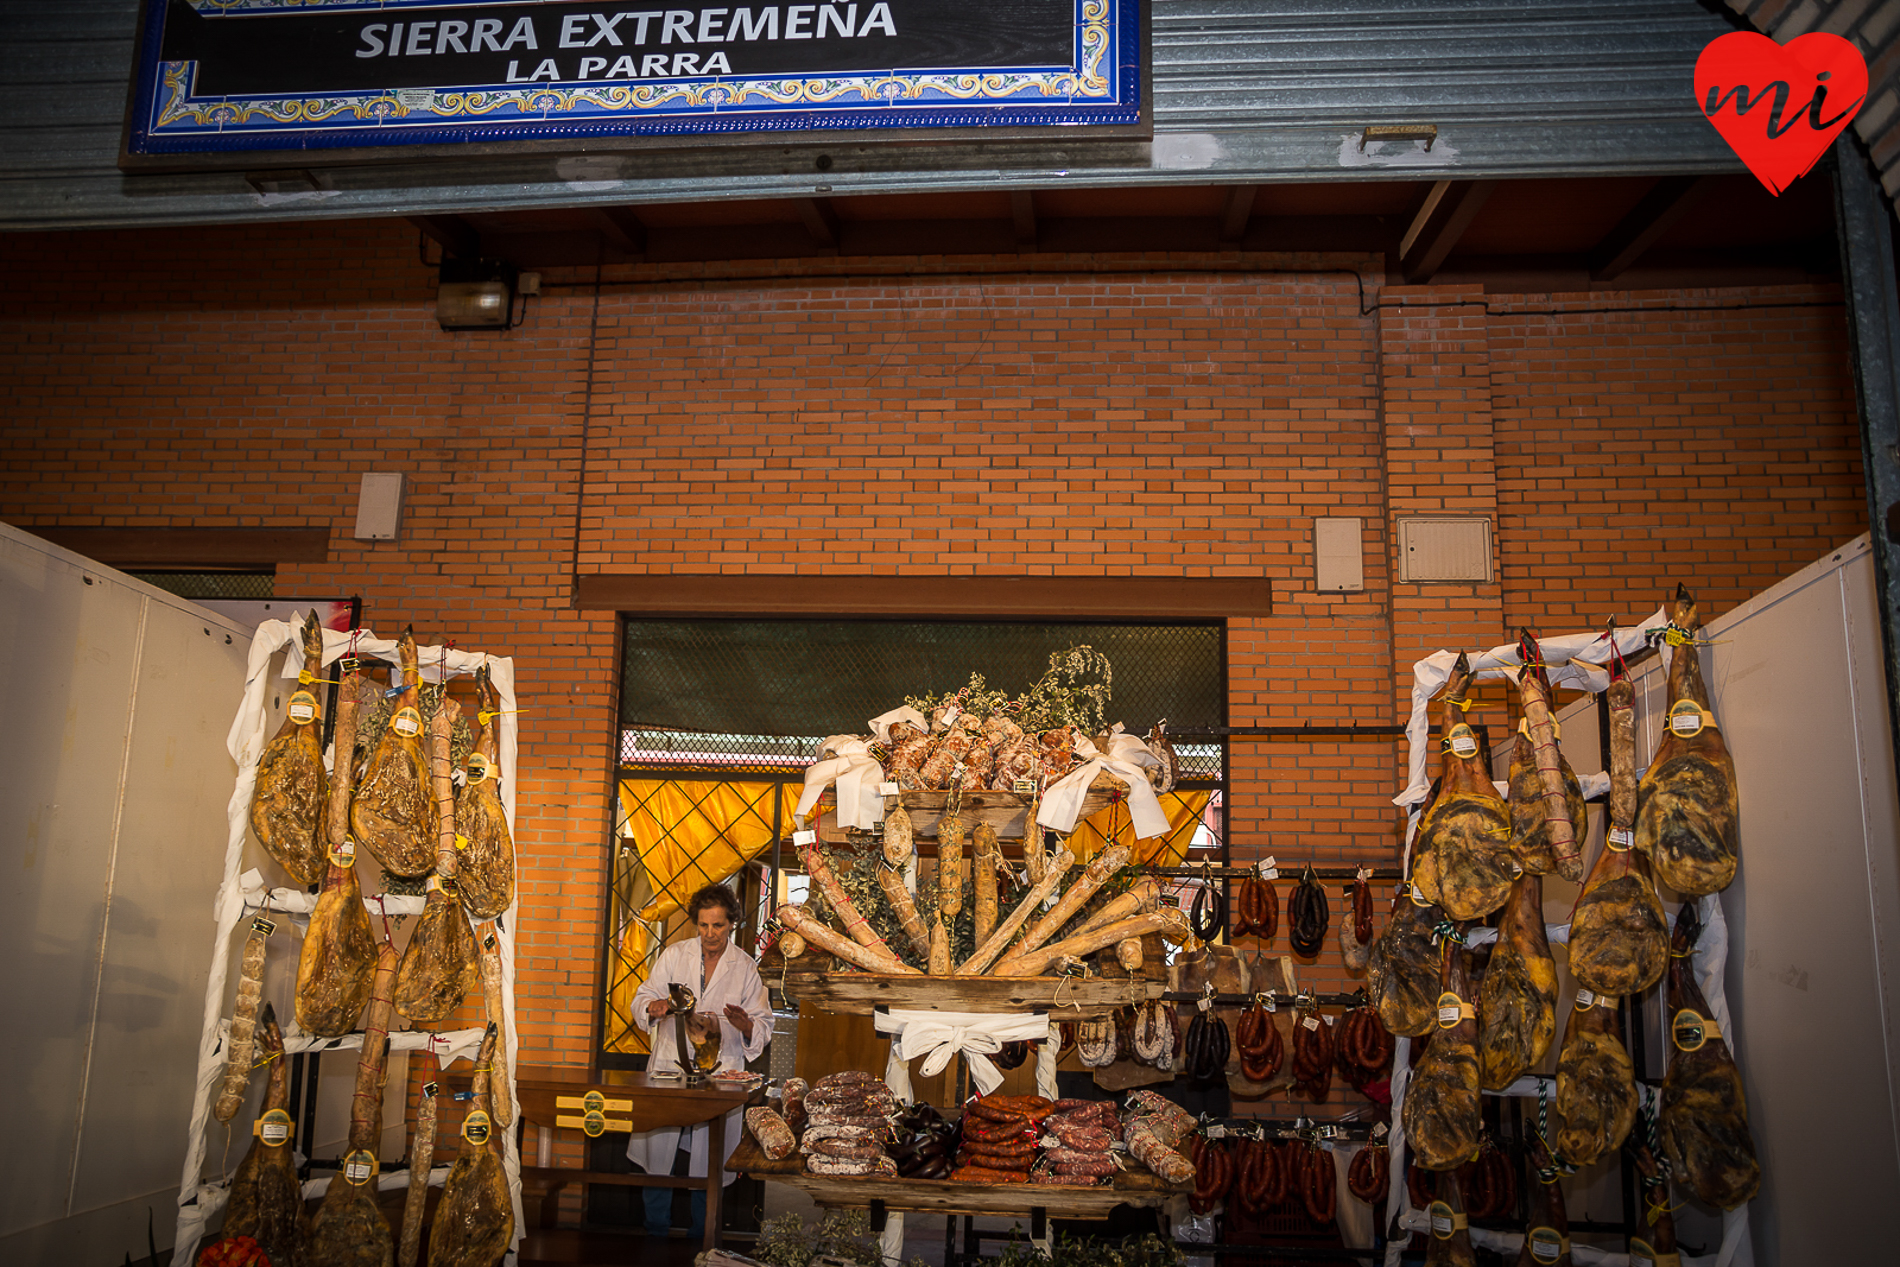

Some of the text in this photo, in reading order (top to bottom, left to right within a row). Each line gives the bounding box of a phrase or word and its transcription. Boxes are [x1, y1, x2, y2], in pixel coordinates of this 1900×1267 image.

[355, 0, 898, 58] SIERRA EXTREMEÑA
[506, 51, 733, 83] LA PARRA
